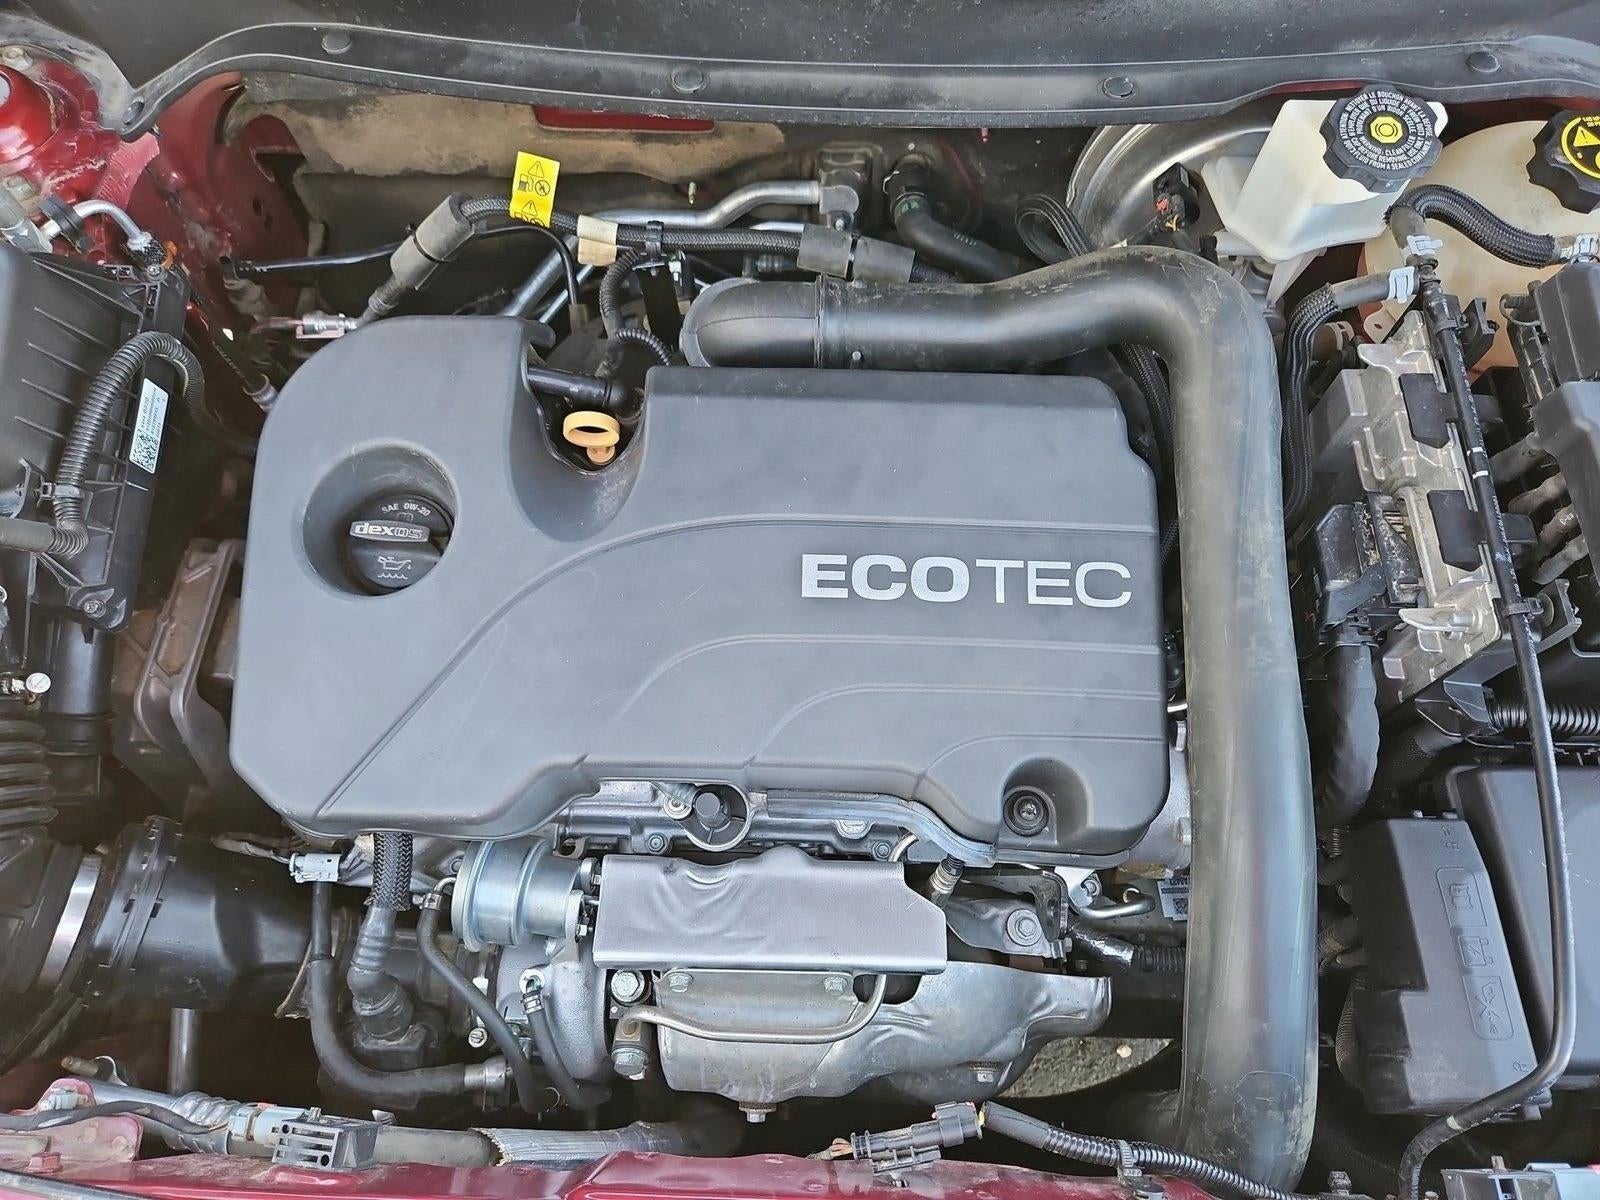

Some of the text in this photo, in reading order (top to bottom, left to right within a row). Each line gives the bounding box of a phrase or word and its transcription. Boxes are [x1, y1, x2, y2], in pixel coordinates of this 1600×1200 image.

[1345, 93, 1369, 111] NETTOYER
[1376, 91, 1404, 101] BOUCHON
[1403, 98, 1421, 111] AVANT
[1418, 110, 1426, 119] LA
[1358, 101, 1370, 111] QUE
[1369, 98, 1378, 106] DU
[1379, 97, 1400, 107] LIQUIDE
[1400, 103, 1409, 112] DE
[1407, 109, 1421, 123] FREIN
[1355, 108, 1372, 134] PROVENANT
[1387, 105, 1405, 116] BIDON
[1351, 137, 1361, 147] CAP
[1358, 145, 1379, 160] BEFORE
[1406, 148, 1419, 157] USE
[1413, 137, 1425, 150] ONLY
[1385, 148, 1404, 156] CLEAN
[1401, 135, 1416, 153] FILLER
[1353, 150, 1369, 164] FLUID
[1368, 160, 1386, 170] FROM
[1391, 160, 1413, 170] SEALED
[381, 502, 431, 517] SAE 0W-20
[355, 522, 423, 540] dexos
[801, 554, 1132, 608] ECOTEC
